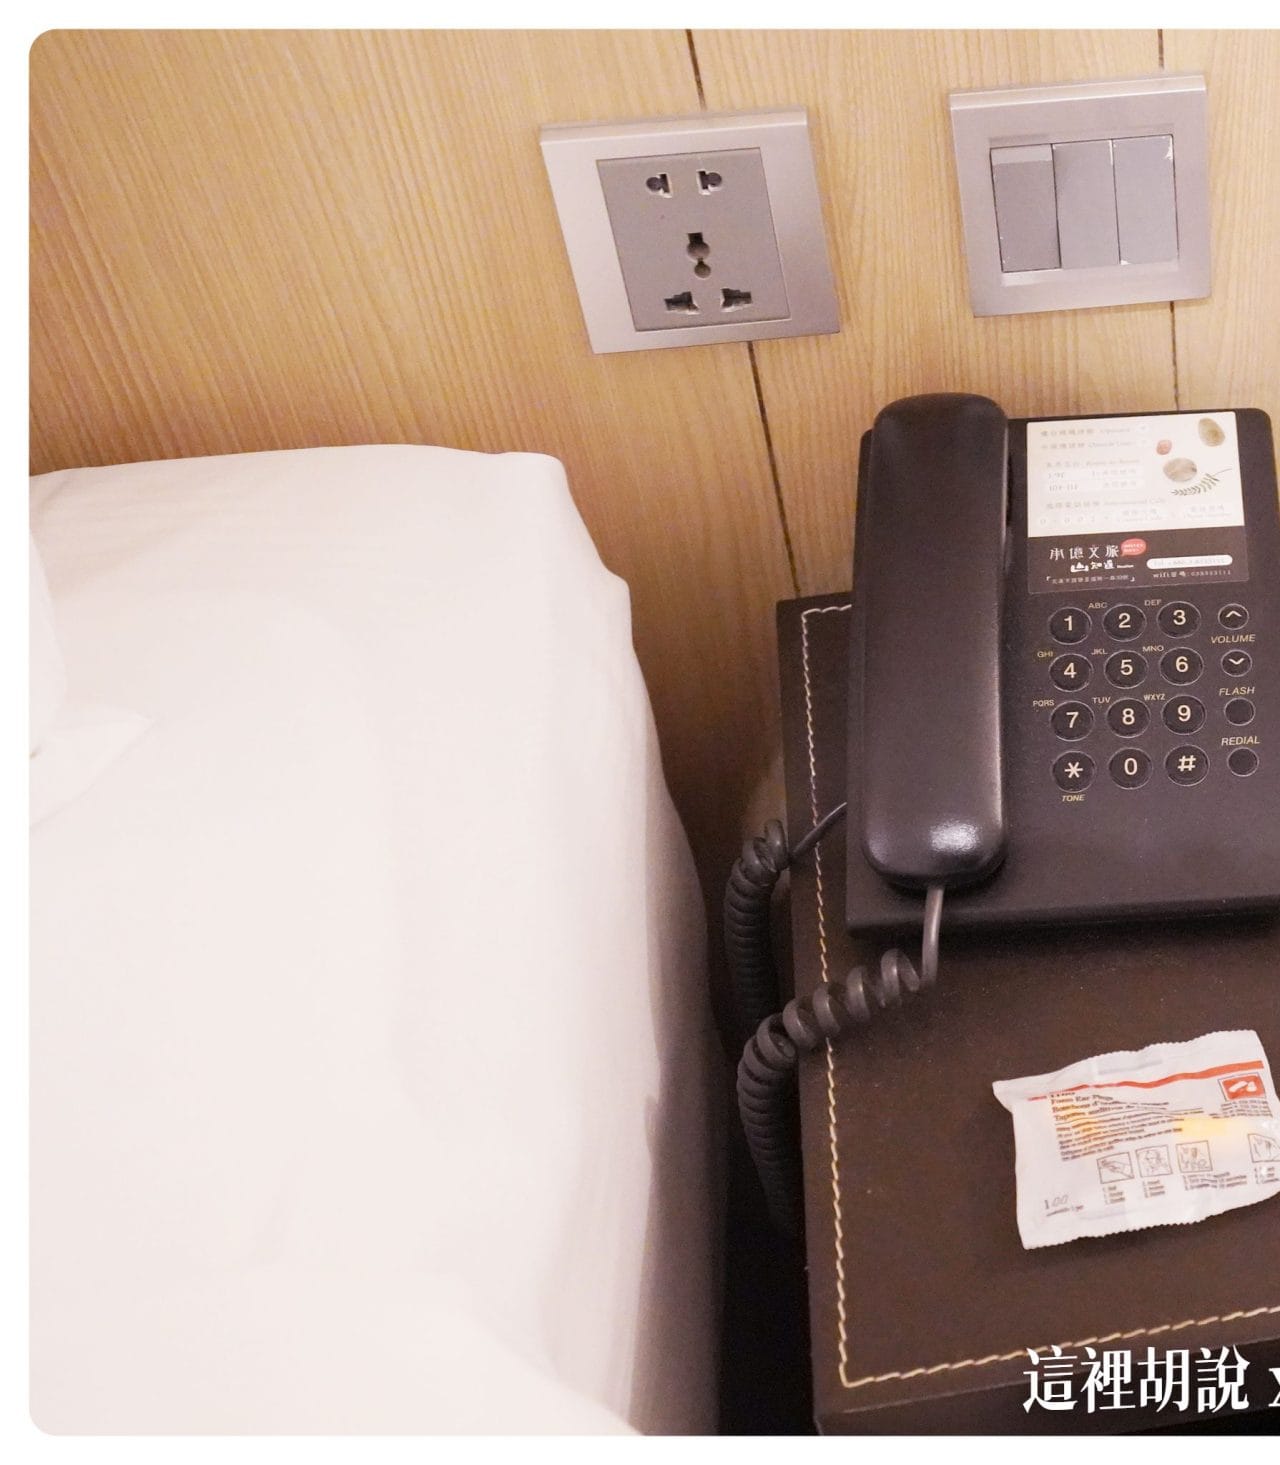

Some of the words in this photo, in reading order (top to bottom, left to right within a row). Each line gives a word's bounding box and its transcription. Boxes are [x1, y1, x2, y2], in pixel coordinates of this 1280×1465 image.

[1088, 602, 1108, 610] ABC
[1064, 615, 1073, 631] 1
[1118, 612, 1131, 629] 2
[1173, 609, 1187, 626] 3
[1210, 633, 1256, 644] VOLUME
[1037, 650, 1053, 658] GHI
[1142, 644, 1165, 652] MNO
[1063, 662, 1077, 679] 4
[1120, 659, 1134, 676] 5
[1175, 656, 1189, 673] 6
[1143, 693, 1166, 701] WXYZ
[1219, 686, 1255, 697] FLASH
[1033, 699, 1055, 707] PQRS
[1092, 696, 1111, 704] TUV
[1066, 711, 1079, 729] 7
[1121, 708, 1135, 725] 8
[1177, 704, 1191, 722] 9
[1221, 735, 1261, 747] REDIAL
[1124, 758, 1138, 775] 0
[1062, 794, 1085, 802] TONE
